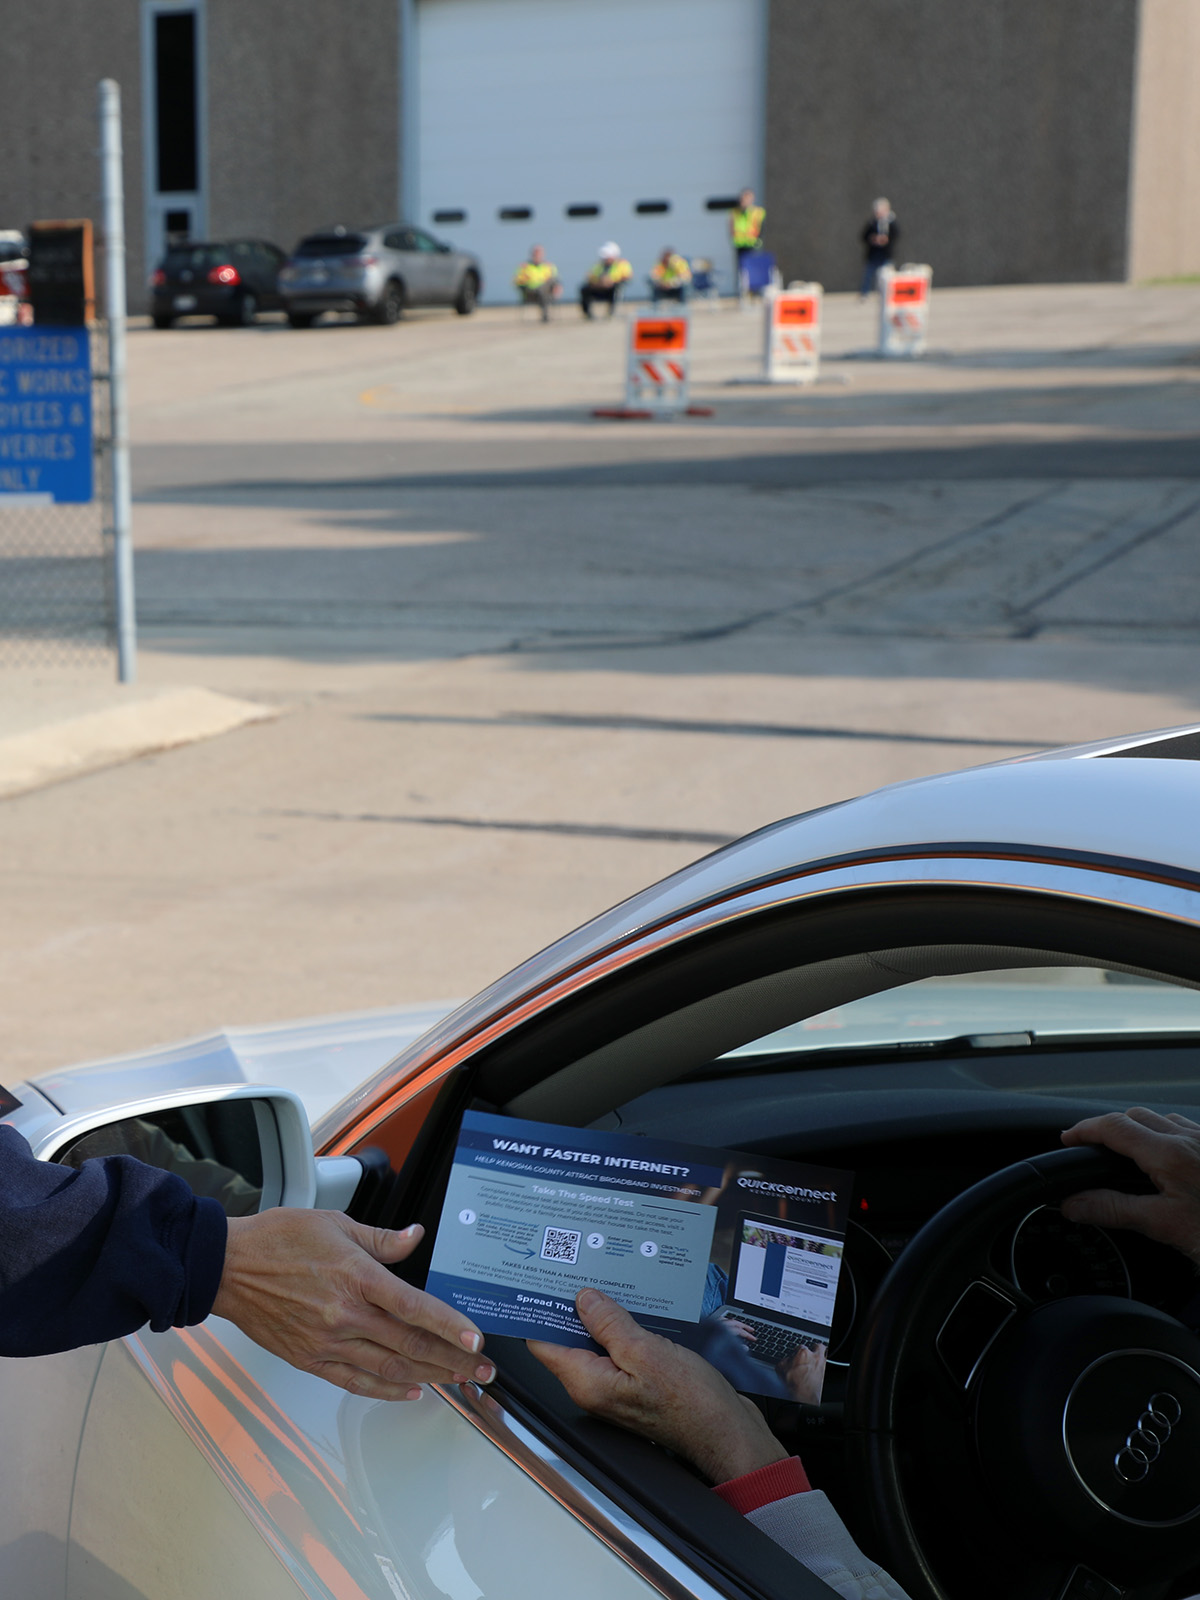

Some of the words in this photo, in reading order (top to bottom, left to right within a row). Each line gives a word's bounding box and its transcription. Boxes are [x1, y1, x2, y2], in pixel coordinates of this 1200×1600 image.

[16, 369, 88, 394] WORKS
[491, 1139, 541, 1156] WANT
[543, 1147, 602, 1165] FASTER
[604, 1156, 690, 1177] INTERNET?
[474, 1155, 496, 1165] HELP
[496, 1159, 533, 1171] KENOSHA
[533, 1166, 565, 1176] COUNTY
[565, 1171, 598, 1181] ATTRACT
[599, 1176, 650, 1189] BROADBAND
[650, 1184, 702, 1197] INVESTMENT!
[531, 1185, 556, 1196] Take
[557, 1189, 577, 1199] The
[578, 1193, 611, 1206] Speed
[612, 1198, 635, 1208] Test
[749, 1189, 787, 1199] KENOSHA
[790, 1196, 821, 1204] COUNTY
[494, 1274, 520, 1283] Kenosha
[521, 1279, 542, 1288] County
[564, 1273, 588, 1281] MINUTE
[599, 1280, 636, 1290] COMPLETE!
[477, 1298, 498, 1306] family,
[499, 1301, 520, 1309] friends
[534, 1309, 564, 1320] neighbors
[516, 1294, 553, 1308] Spread
[555, 1303, 574, 1313] The
[646, 1297, 674, 1305] providers
[467, 1307, 498, 1317] Resources
[510, 1315, 536, 1323] available
[545, 1322, 591, 1338] kenoshacounty
[468, 1302, 493, 1311] chances
[501, 1308, 531, 1318] attracting
[532, 1314, 566, 1324] broadband
[567, 1321, 586, 1330] invest
